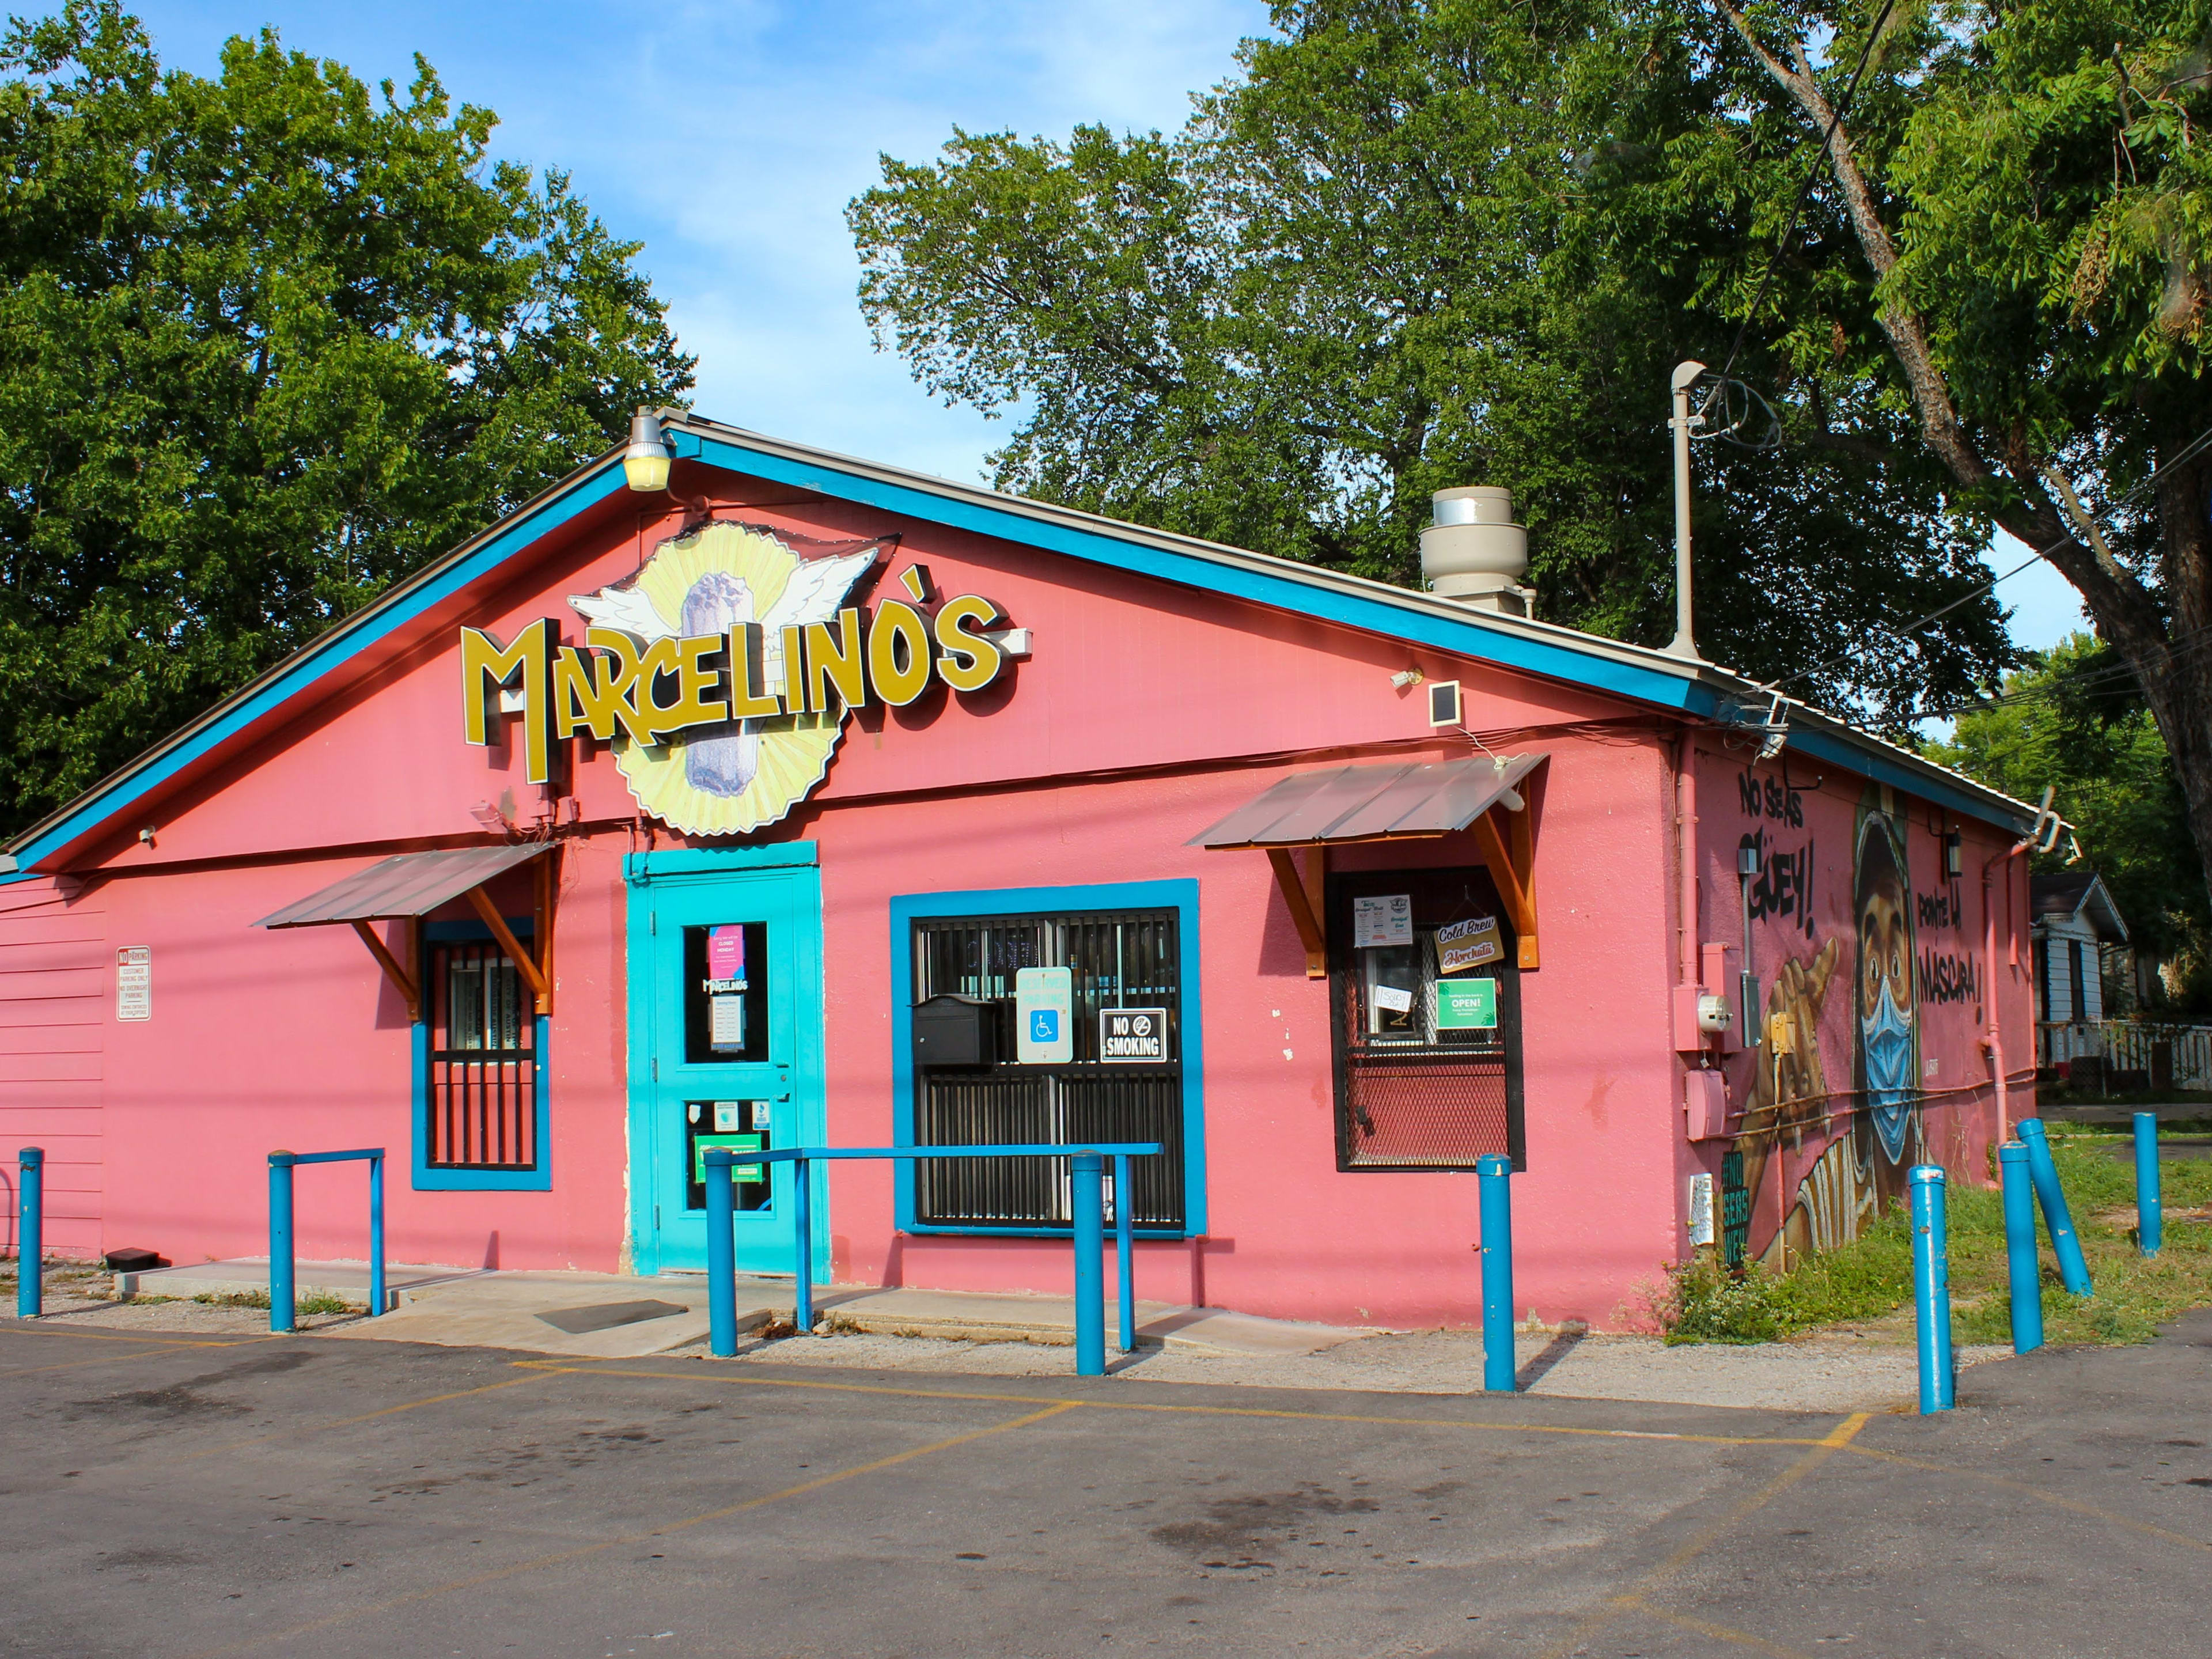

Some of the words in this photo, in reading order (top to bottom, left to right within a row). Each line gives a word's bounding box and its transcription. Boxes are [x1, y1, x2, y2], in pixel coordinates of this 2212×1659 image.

[461, 563, 1008, 784] MARCELINO'S
[1765, 775, 1803, 829] SEAS
[1439, 923, 1464, 942] Cold
[1467, 919, 1494, 934] Brew
[119, 952, 128, 963] NO
[1445, 944, 1494, 966] Horchata
[1452, 998, 1480, 1007] OPEN!
[1113, 1016, 1129, 1036] NO
[1107, 1036, 1159, 1056] SMOKING
[1724, 1190, 1748, 1226] SEAS
